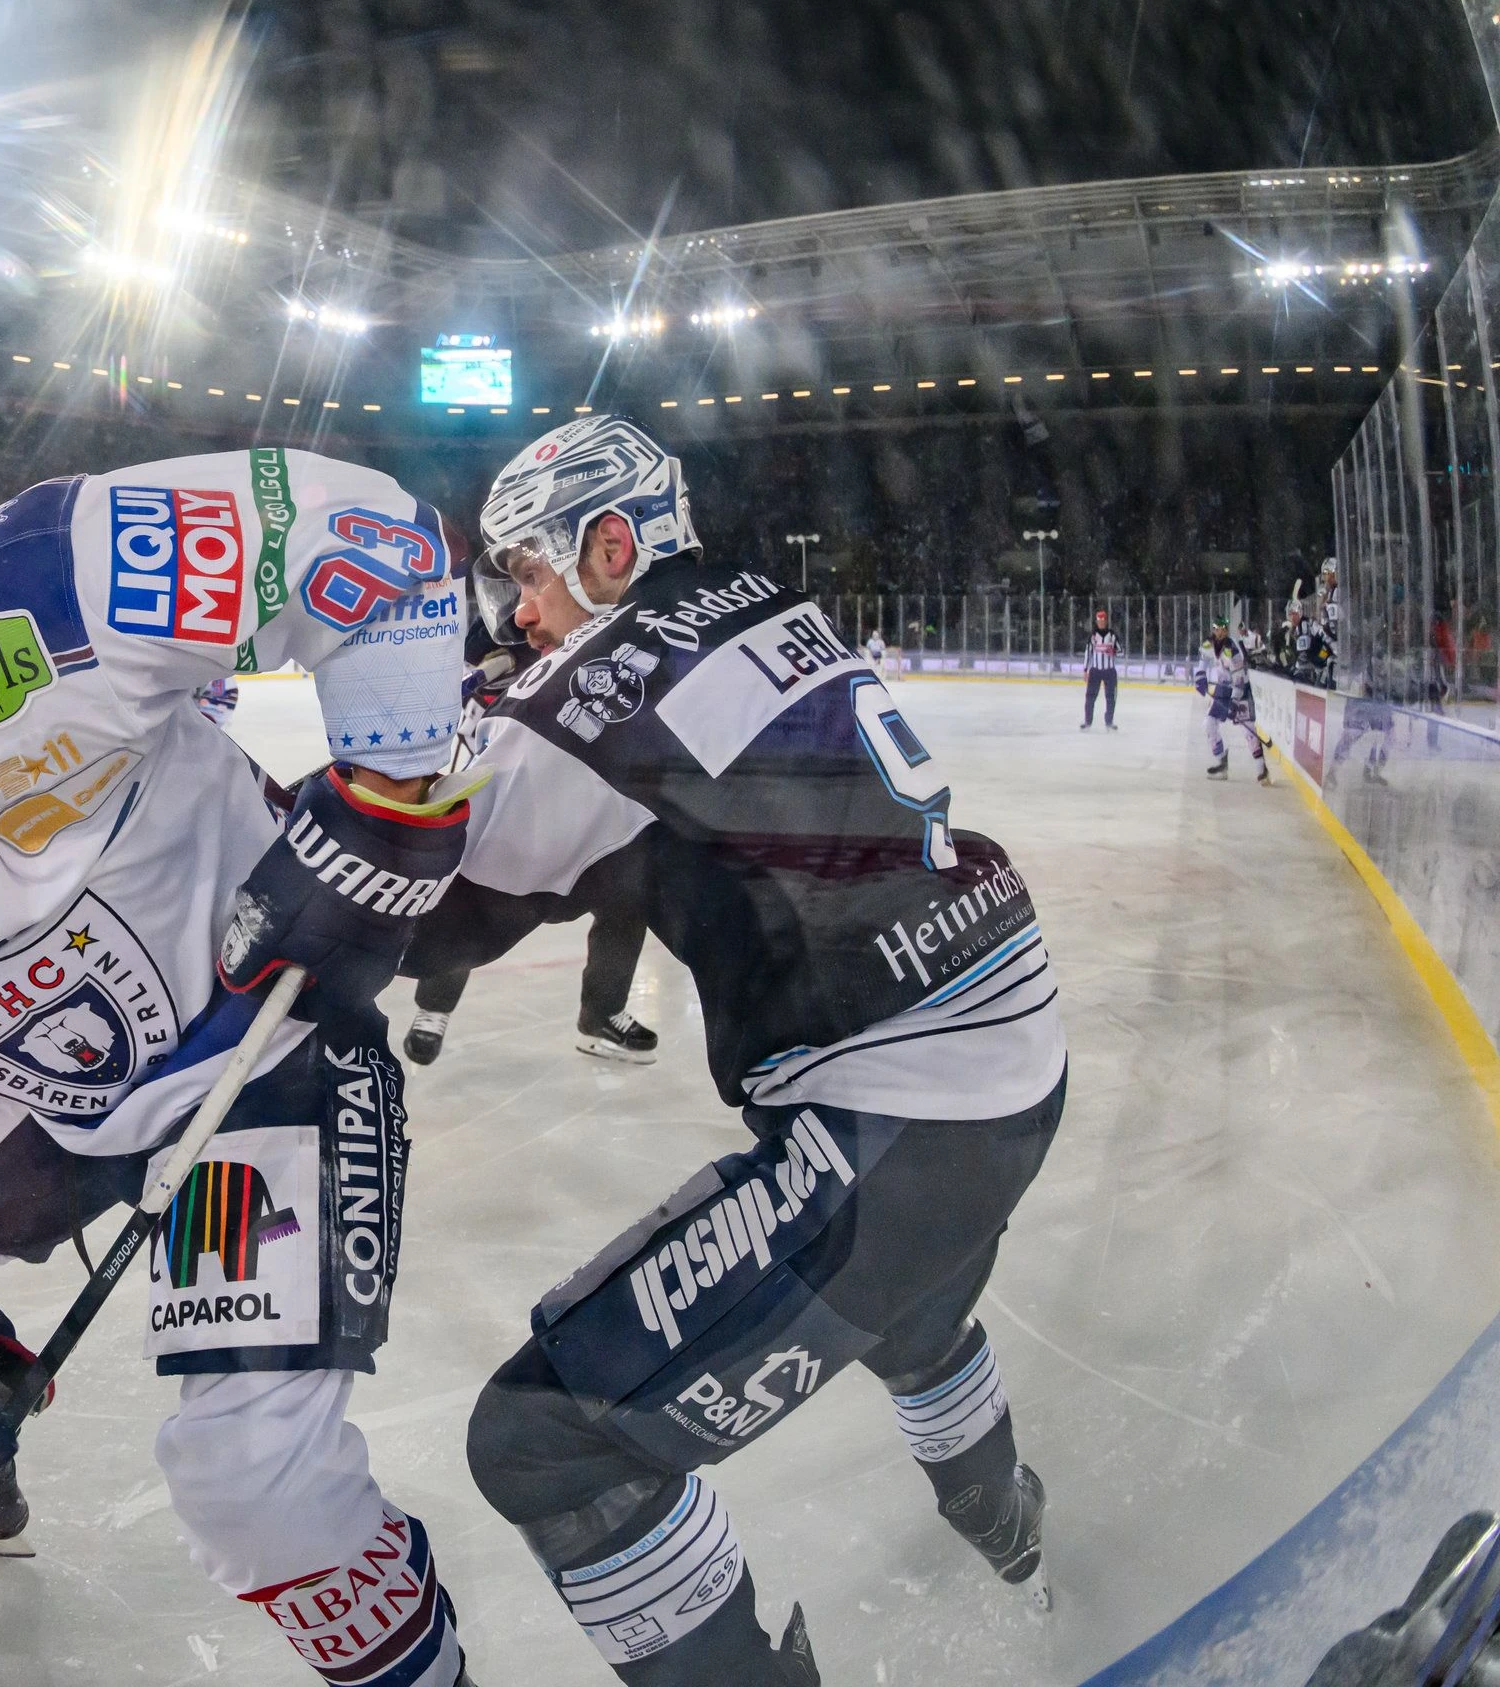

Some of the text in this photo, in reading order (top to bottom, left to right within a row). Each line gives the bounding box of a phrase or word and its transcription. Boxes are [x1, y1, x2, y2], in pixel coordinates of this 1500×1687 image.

[114, 490, 236, 635] LIQUI MOLY
[301, 507, 445, 632] 93
[551, 552, 577, 564] BAUER
[636, 571, 784, 652] Feldsch
[738, 611, 864, 694] LeBL
[43, 731, 83, 773] 11
[94, 950, 168, 1067] BERLIN
[325, 1045, 381, 1305] CONTIPAK
[151, 1292, 281, 1332] CAPAROL
[676, 1371, 764, 1436] P&N
[918, 1441, 951, 1455] SSS
[260, 1519, 408, 1630] ELBANK
[623, 1526, 668, 1560] BERLIN
[696, 1556, 735, 1602] SSS
